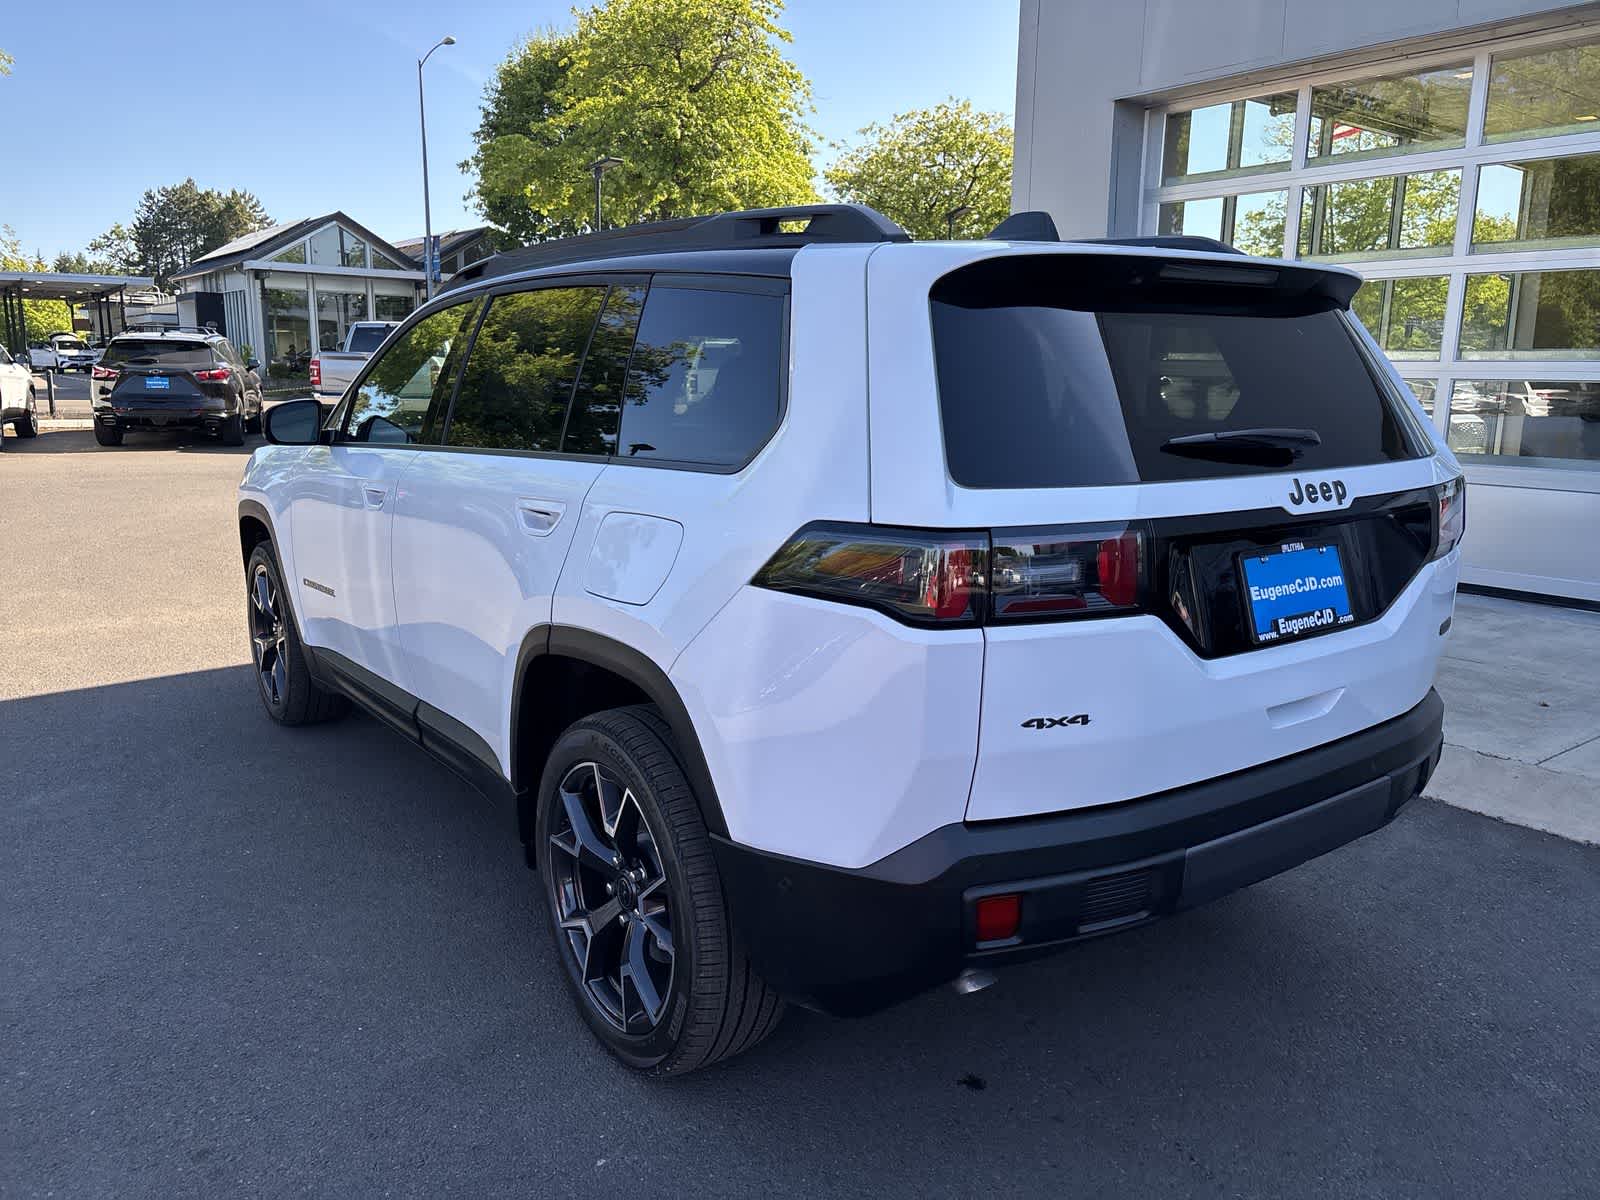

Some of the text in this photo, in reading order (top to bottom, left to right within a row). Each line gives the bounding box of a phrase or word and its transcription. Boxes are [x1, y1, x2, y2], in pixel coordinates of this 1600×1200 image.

[1288, 478, 1348, 506] Jeep
[1250, 575, 1342, 601] EugeneCJD.com
[1258, 608, 1354, 641] www. EugeneCJD .com
